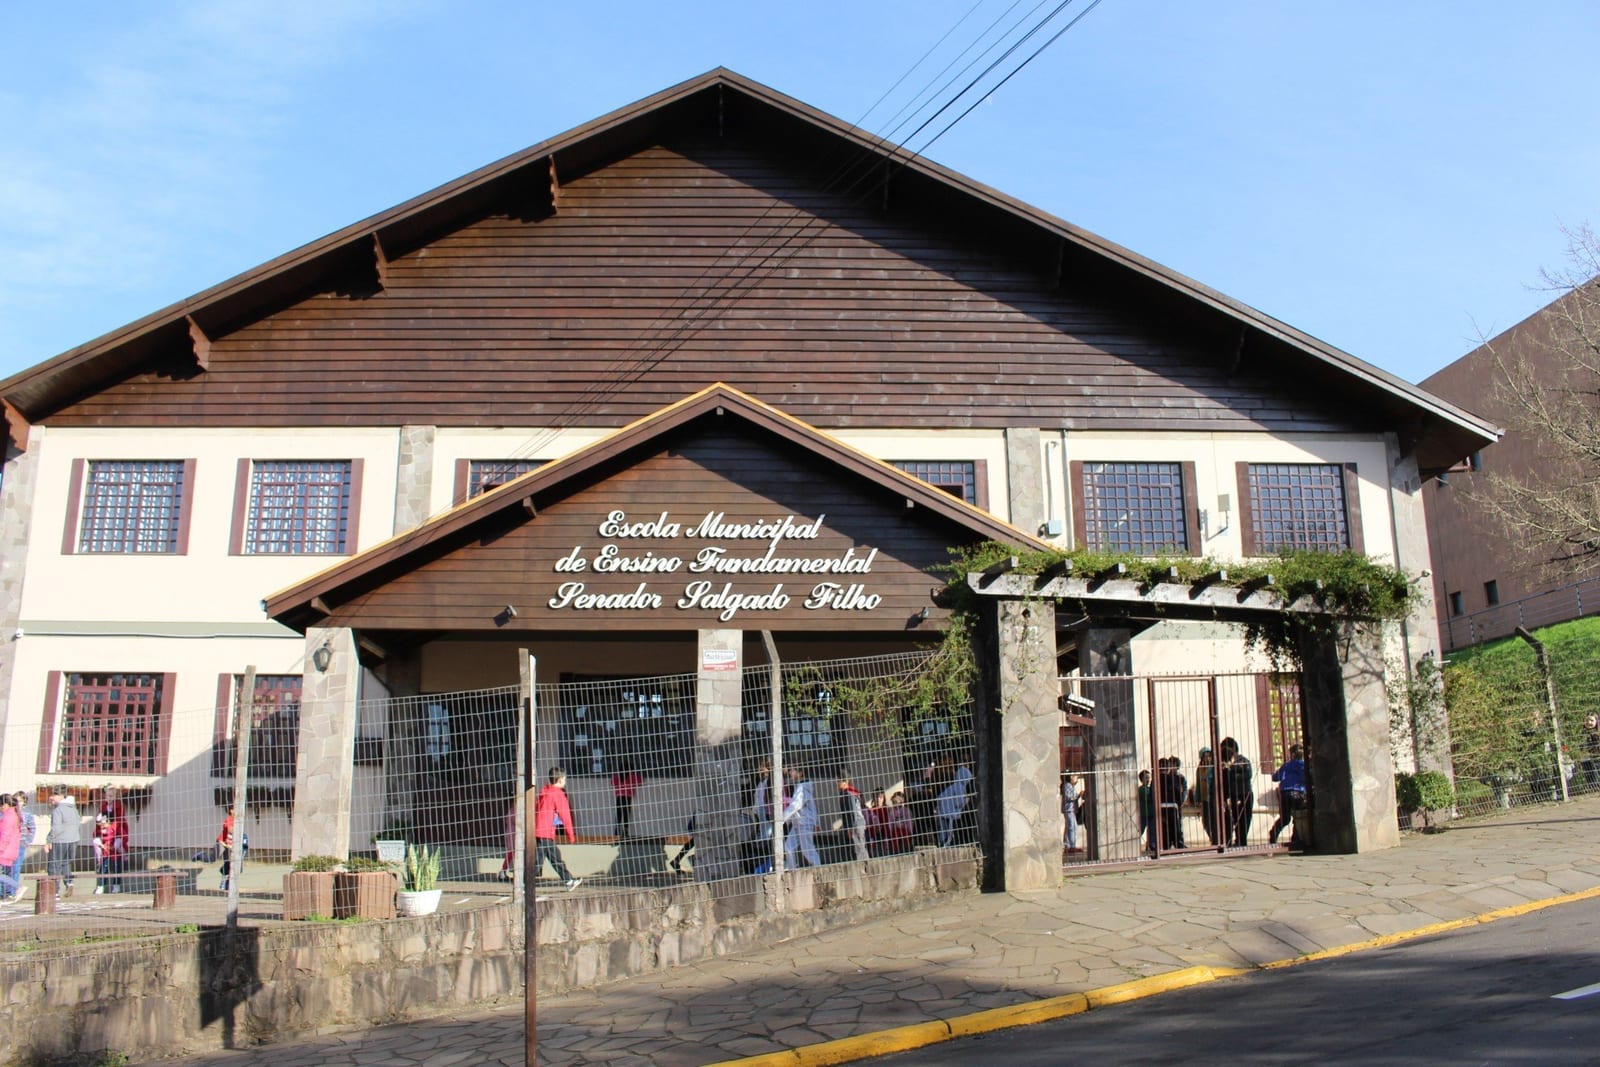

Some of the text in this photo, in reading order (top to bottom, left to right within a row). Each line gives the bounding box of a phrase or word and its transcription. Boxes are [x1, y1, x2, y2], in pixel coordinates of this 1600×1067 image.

[598, 510, 825, 549] Escola Municipal
[554, 545, 878, 574] de Ensino Fundamental
[548, 581, 882, 621] Senador Salgado Filho
